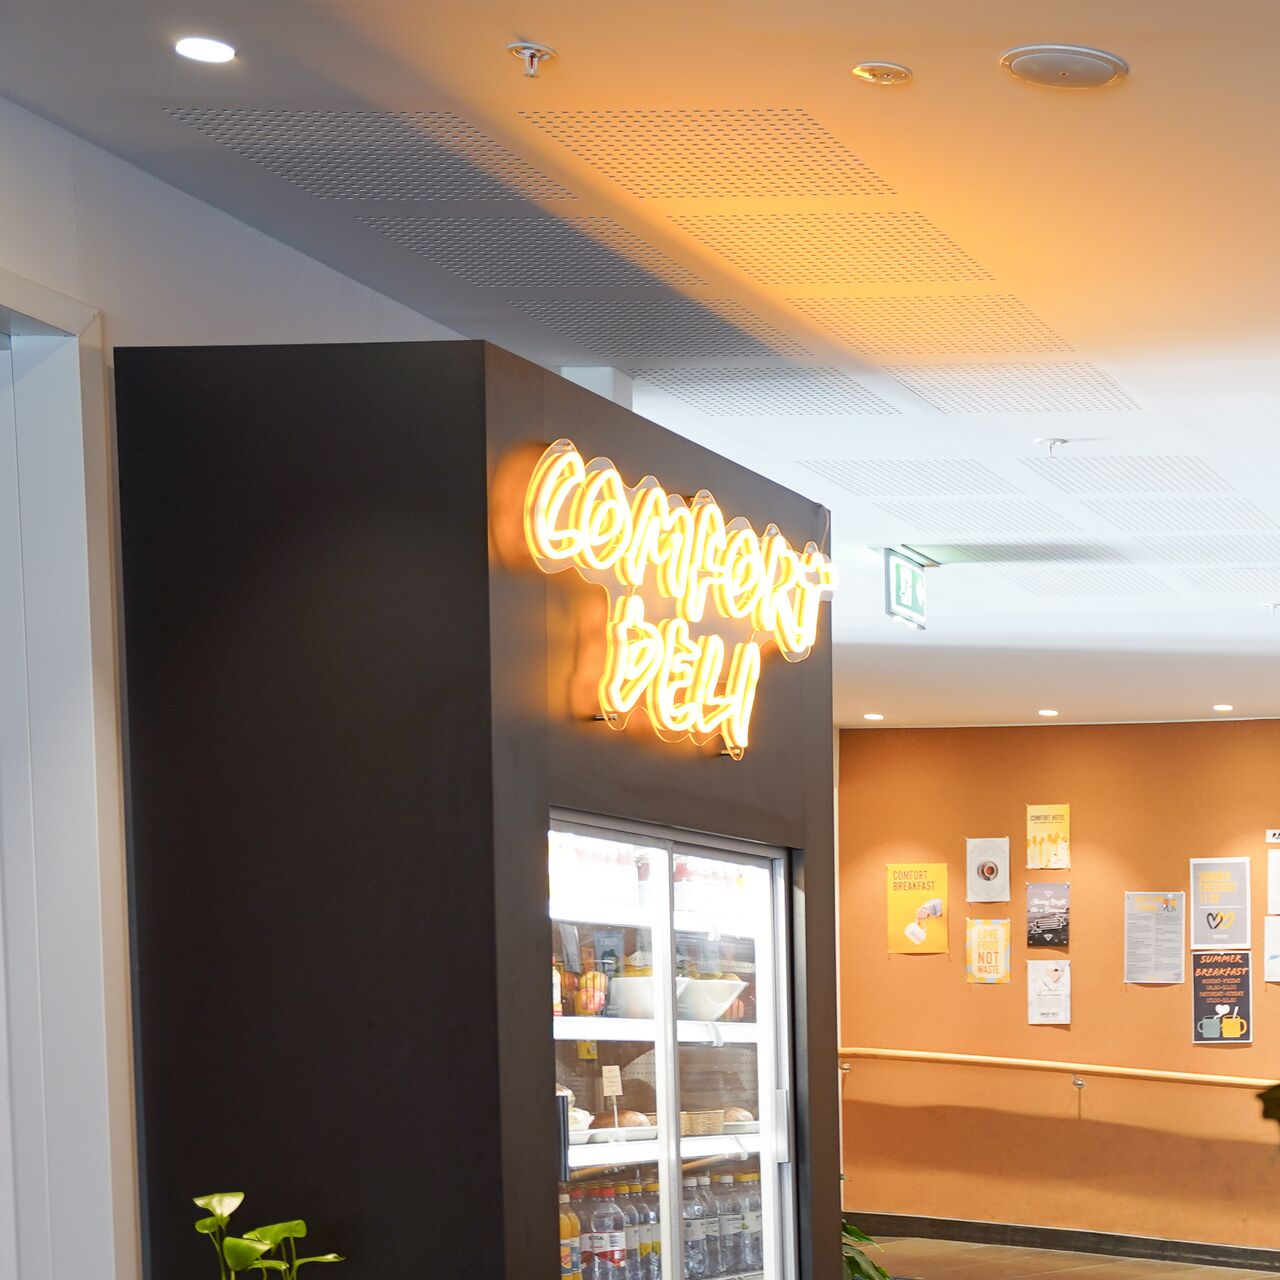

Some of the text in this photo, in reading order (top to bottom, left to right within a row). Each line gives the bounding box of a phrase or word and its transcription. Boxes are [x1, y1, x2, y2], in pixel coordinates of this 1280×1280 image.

[526, 450, 838, 653] COMFORT
[602, 596, 760, 748] DELI
[893, 870, 928, 880] COMFORT
[893, 881, 936, 891] BREAKFAST
[977, 951, 1000, 964] NOT
[1200, 955, 1243, 963] SUMMER
[976, 964, 1000, 974] WASTE
[1195, 967, 1248, 976] BREAKFAST
